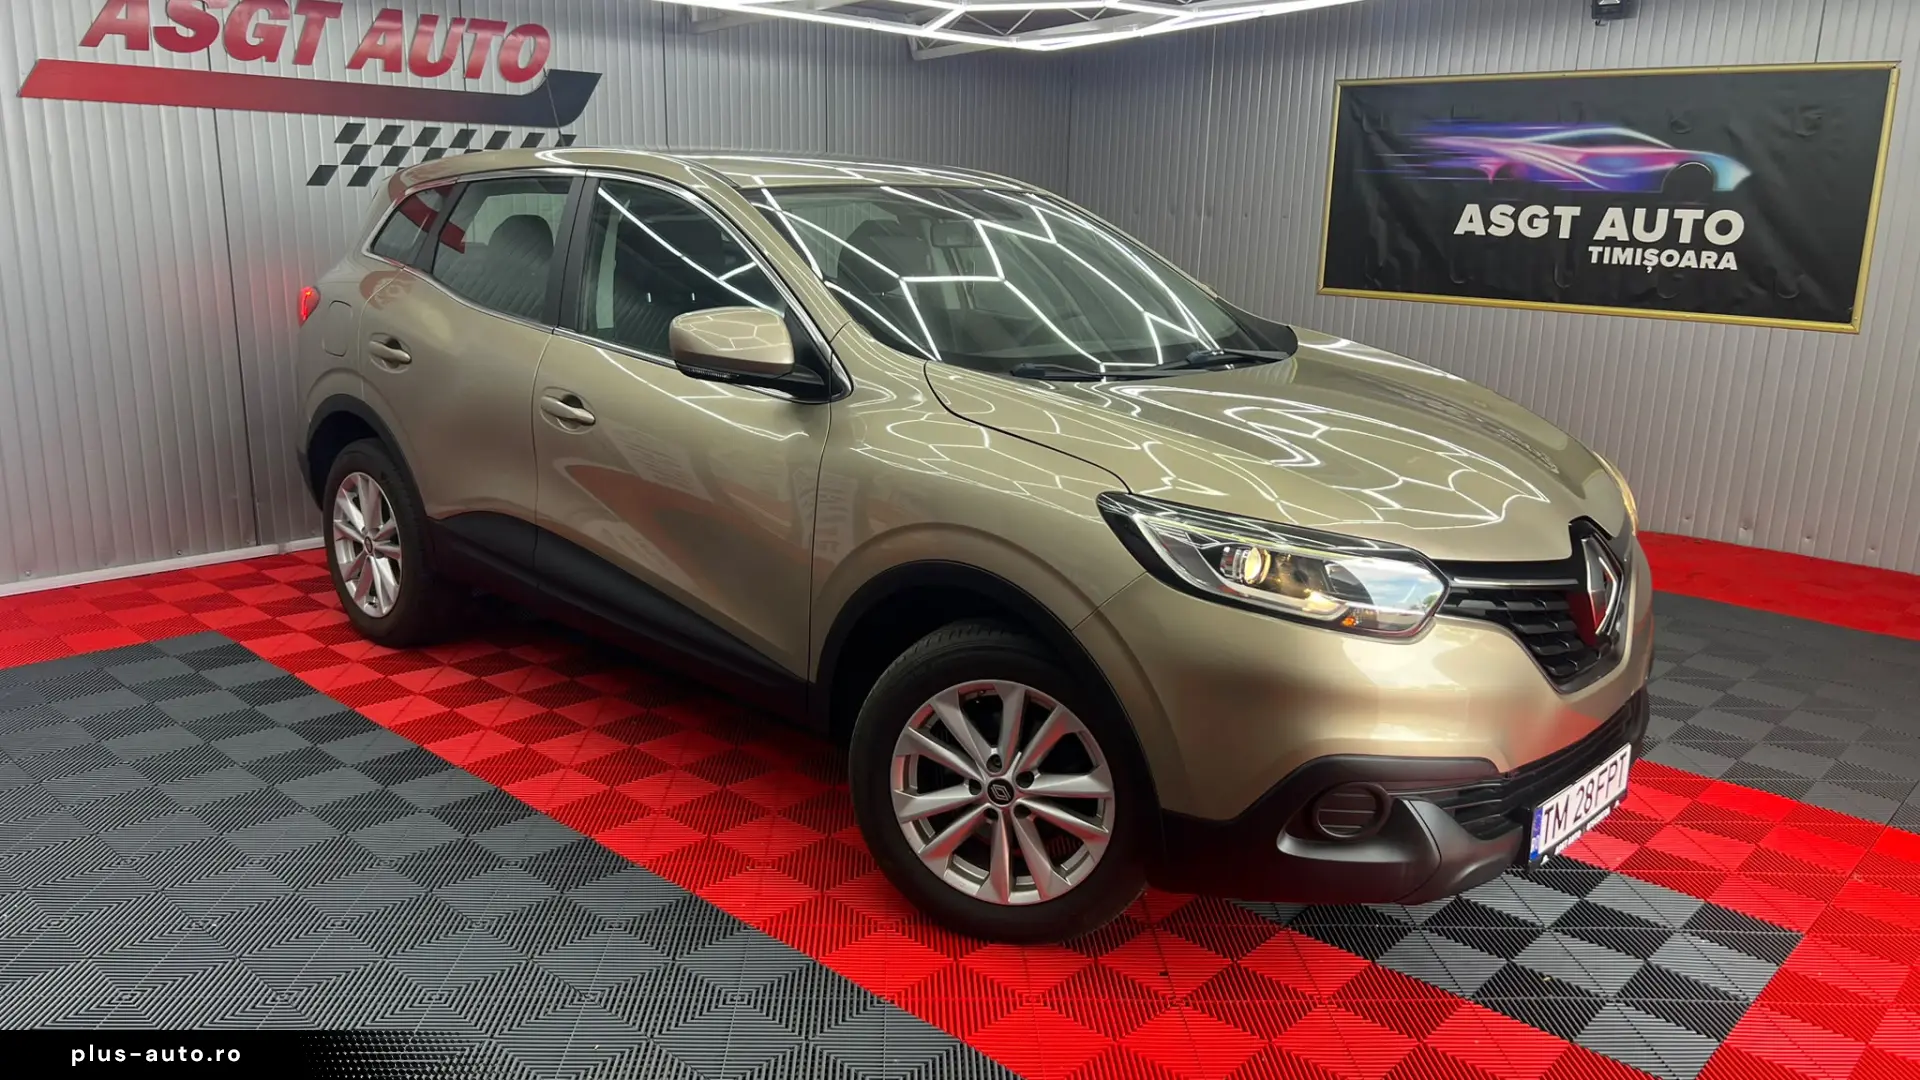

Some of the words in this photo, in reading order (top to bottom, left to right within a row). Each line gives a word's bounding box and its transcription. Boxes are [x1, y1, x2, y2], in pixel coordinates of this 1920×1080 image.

[78, 0, 343, 66] ASGT
[346, 8, 551, 83] AUTO
[1453, 203, 1581, 239] ASGT
[1593, 207, 1745, 246] AUTO
[1544, 795, 1570, 845] TM
